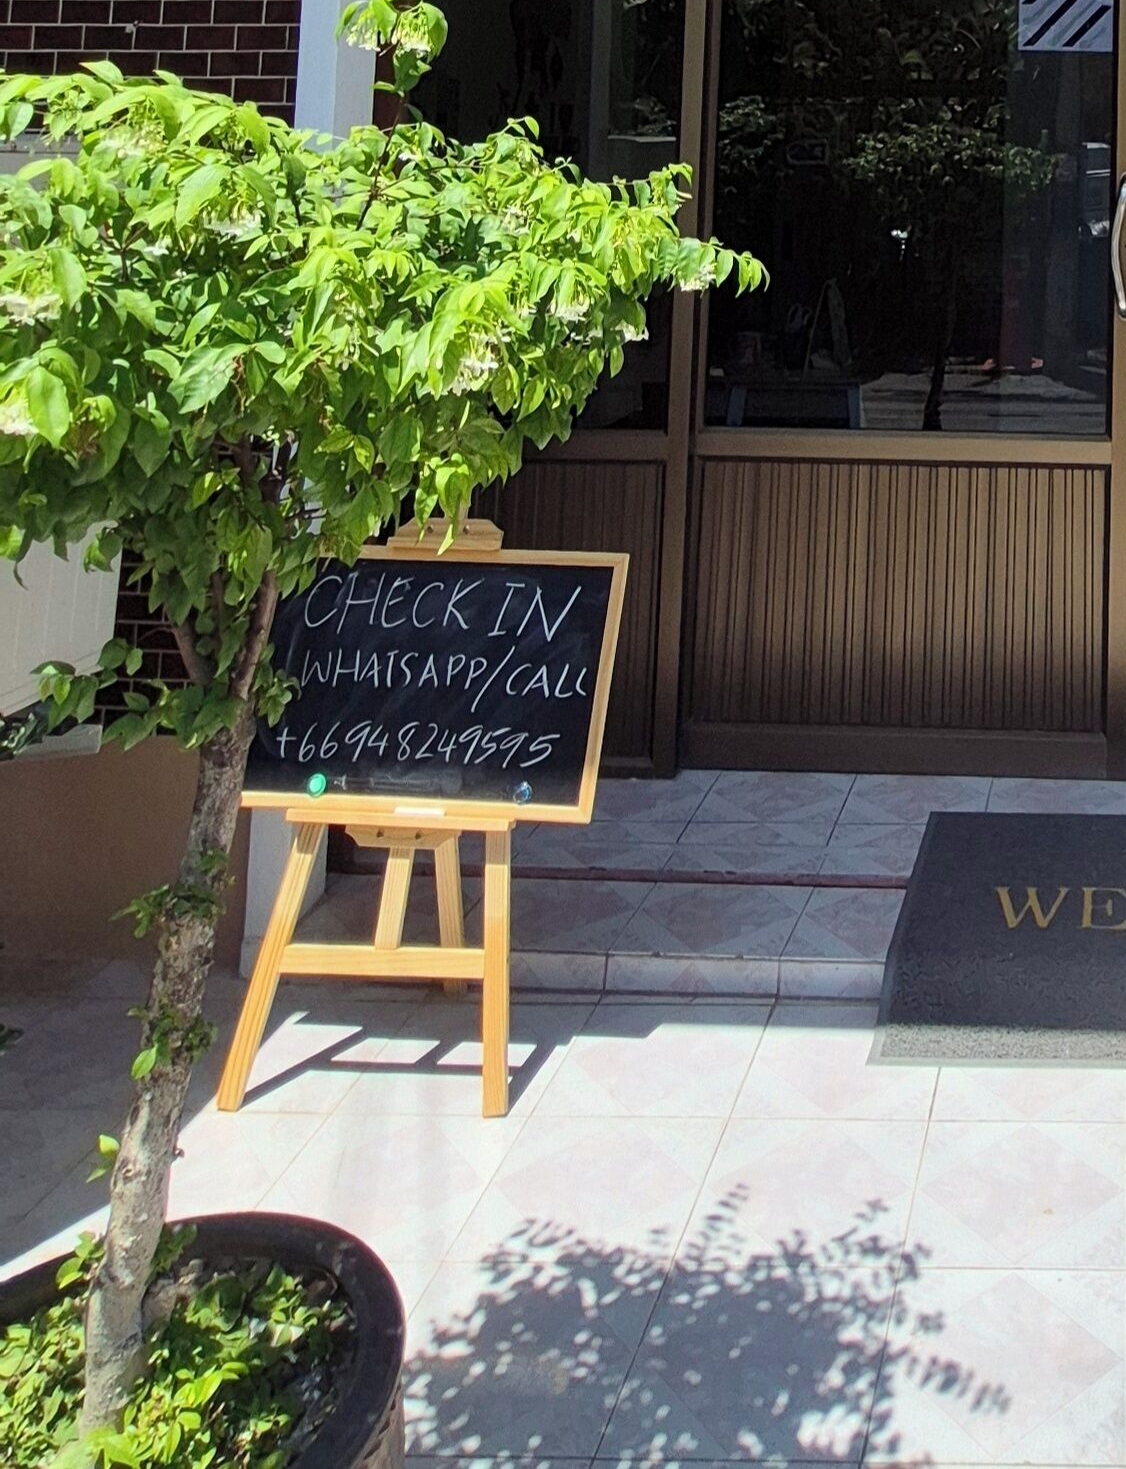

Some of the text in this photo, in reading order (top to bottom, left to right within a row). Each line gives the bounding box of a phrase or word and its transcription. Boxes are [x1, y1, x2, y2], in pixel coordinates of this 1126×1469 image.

[304, 571, 582, 642] CHECK IN
[301, 646, 587, 713] WHATSAPP/CALL
